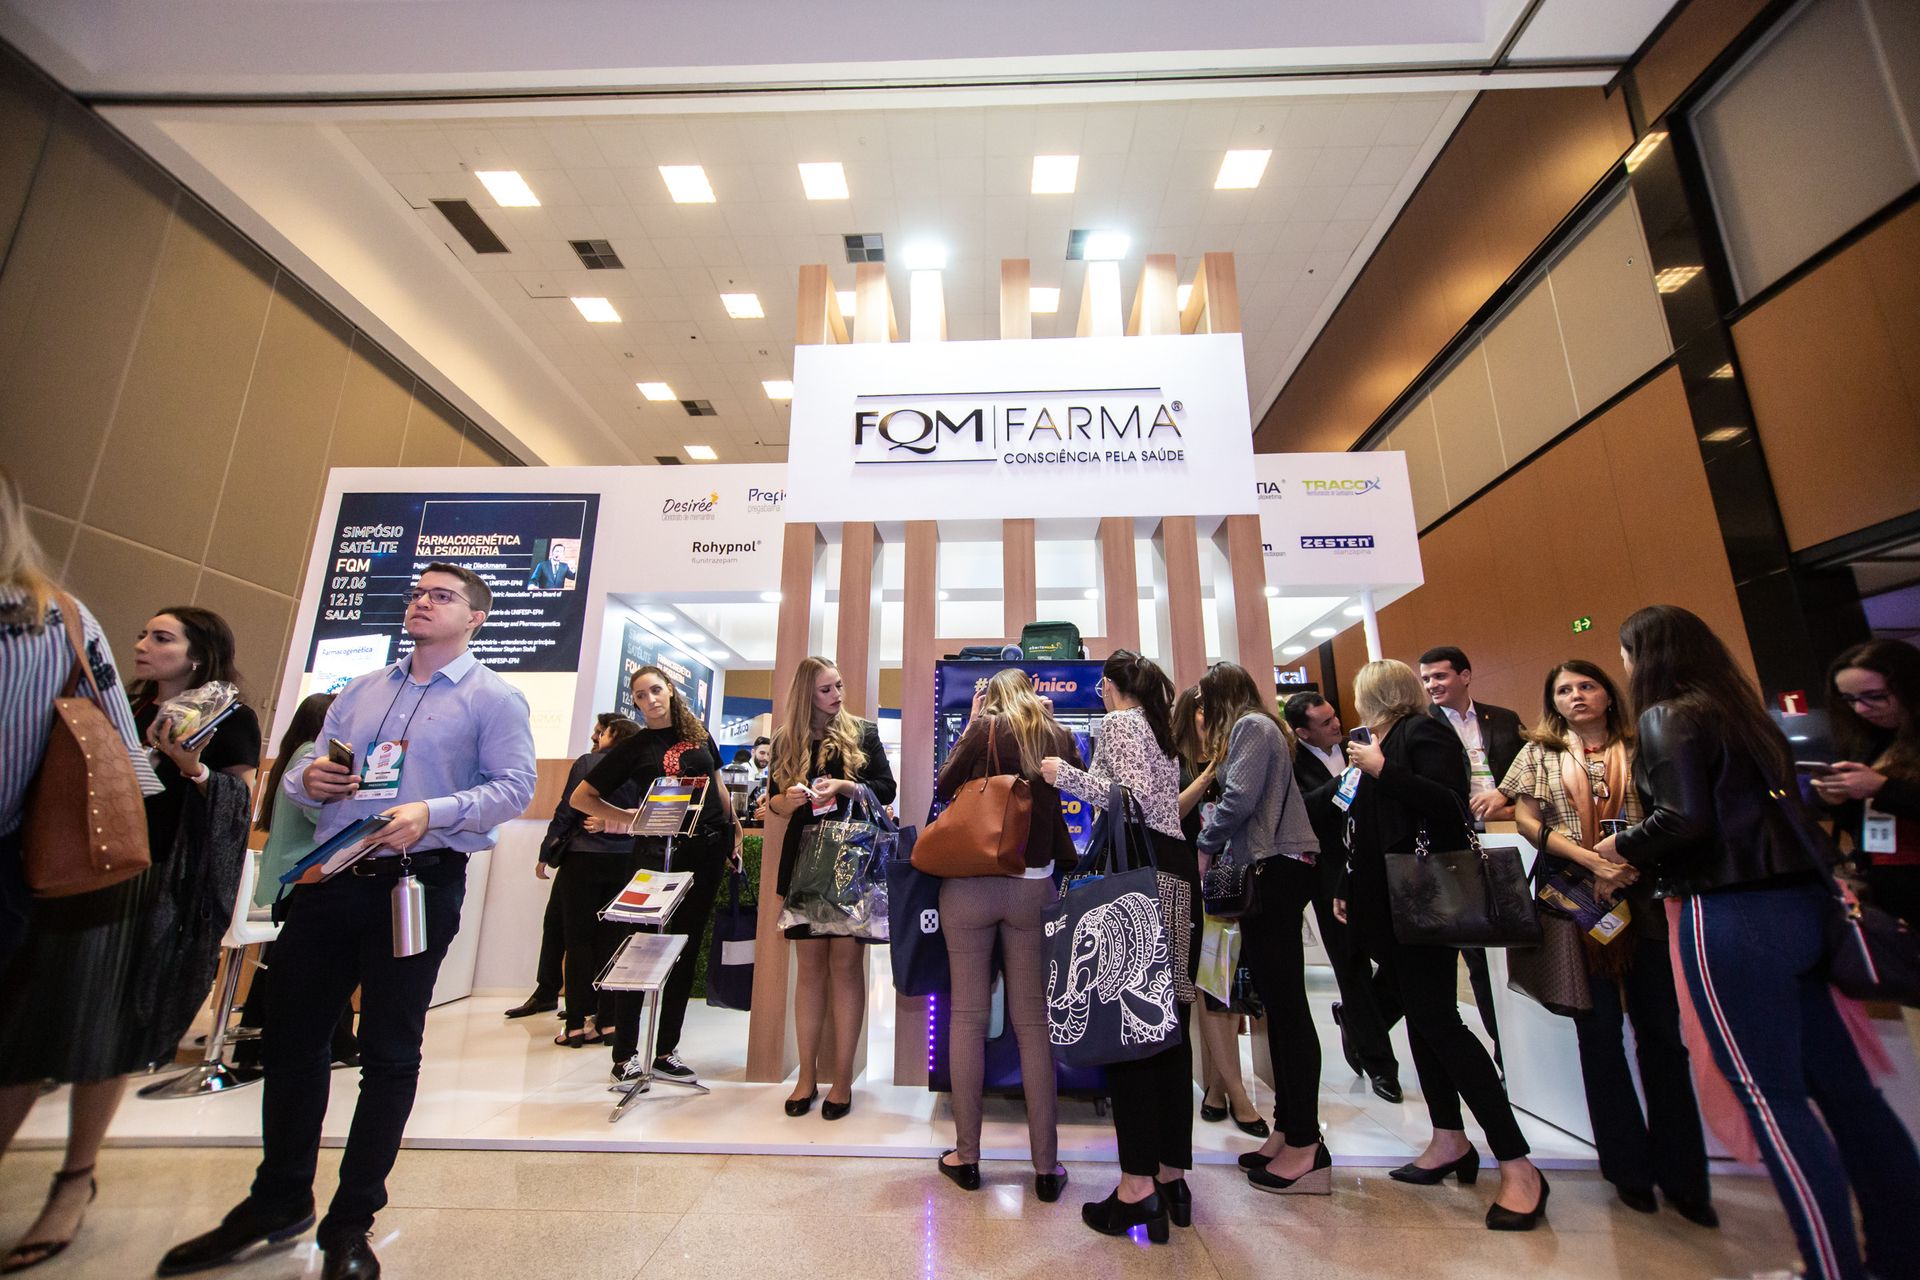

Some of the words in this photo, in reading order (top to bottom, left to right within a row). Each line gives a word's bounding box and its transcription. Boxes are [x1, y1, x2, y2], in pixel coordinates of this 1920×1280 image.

[854, 408, 983, 455] FQM
[1003, 448, 1101, 464] CONSCIÊNCIA
[1105, 450, 1137, 463] PELA
[1141, 447, 1185, 462] SAÚDE
[662, 497, 713, 514] Desirée
[342, 523, 404, 538] SIMPÓSIO
[339, 539, 399, 554] SATÉLITE
[418, 533, 521, 546] FARMACOGENÉTICA
[415, 545, 431, 556] NA
[433, 545, 500, 556] PSIQUIATRIA
[335, 558, 371, 573] FQM
[331, 576, 367, 590] 07.06
[329, 592, 364, 606] 12:15
